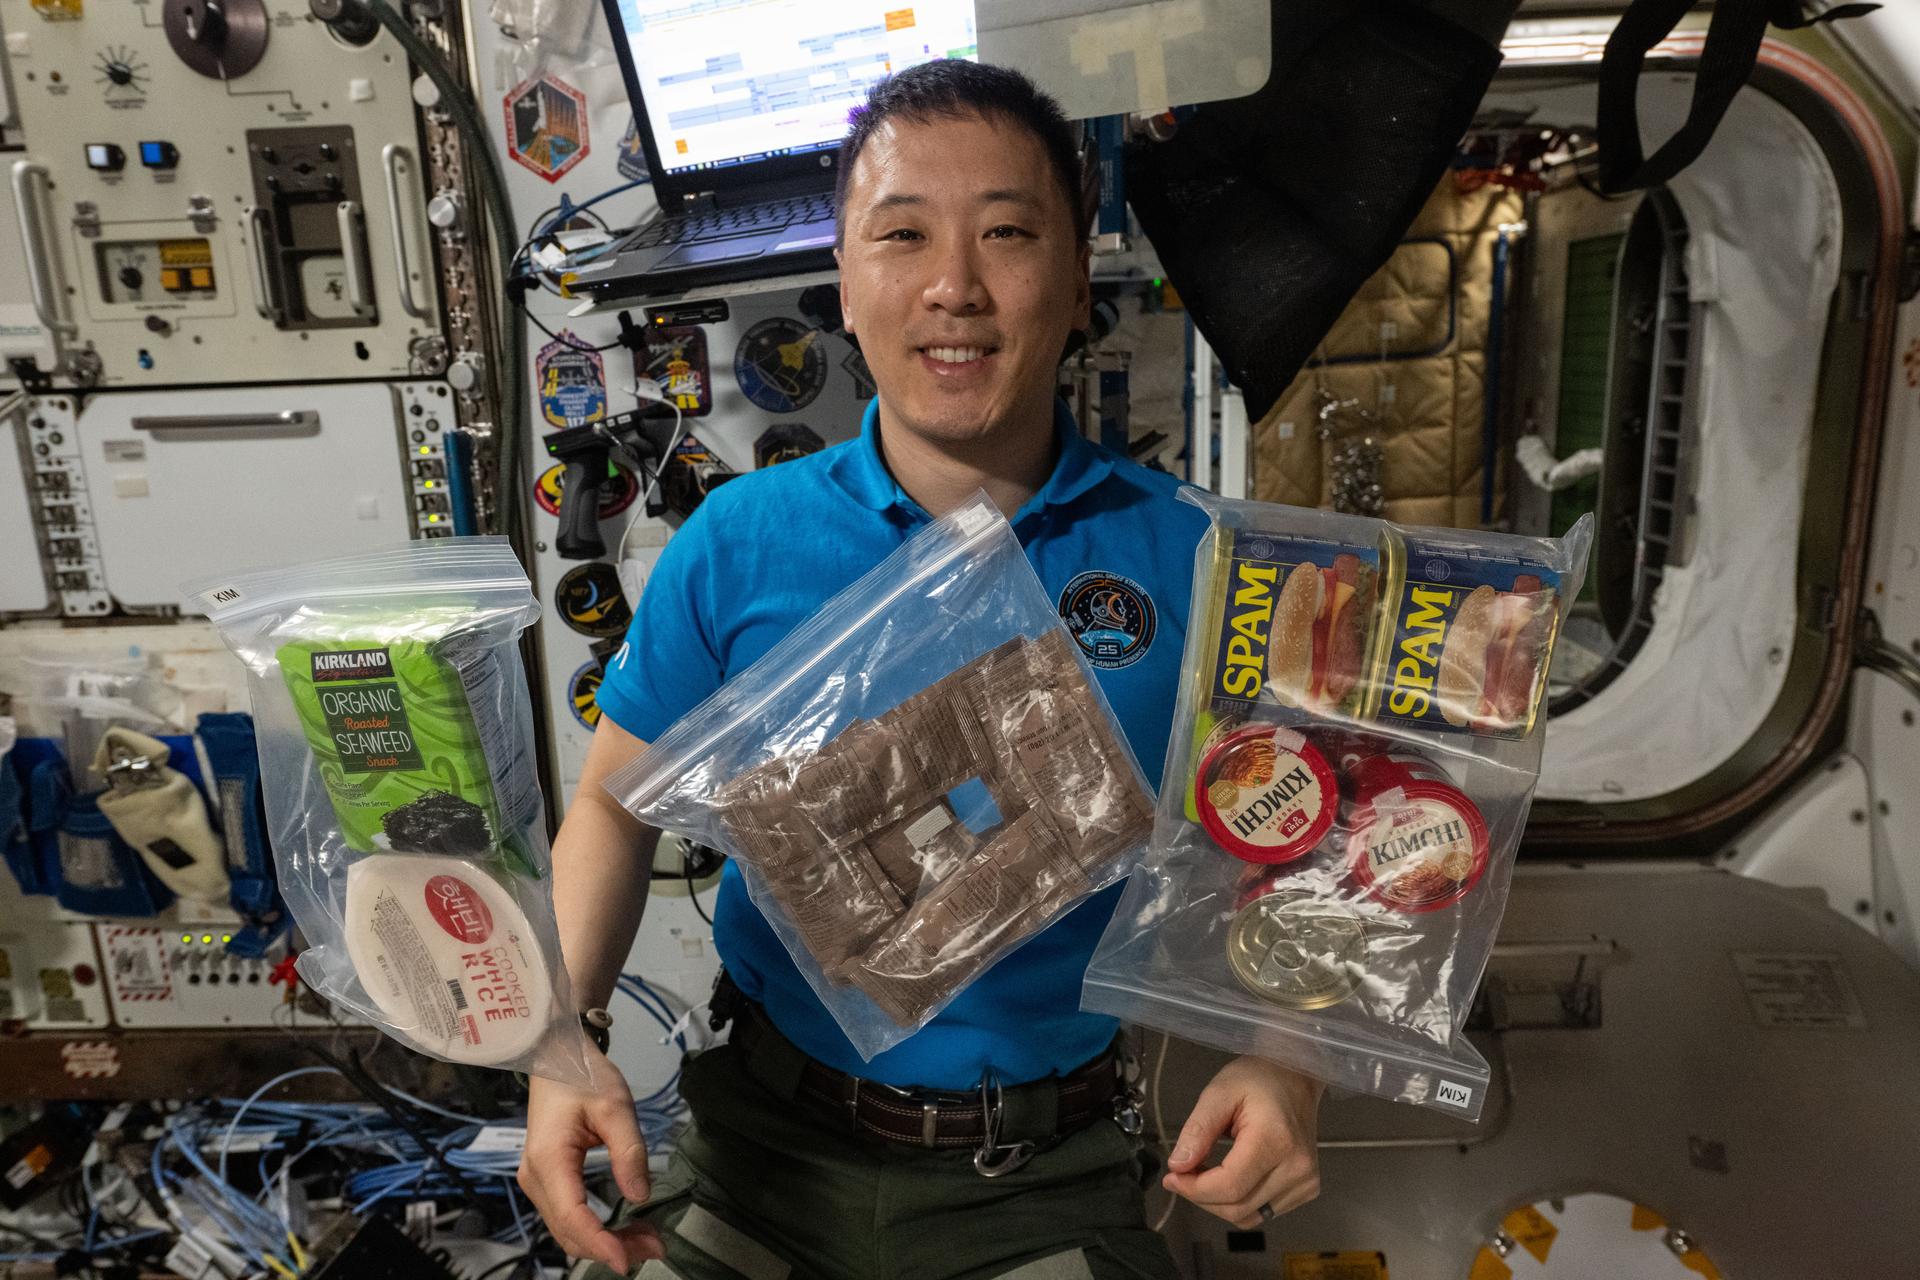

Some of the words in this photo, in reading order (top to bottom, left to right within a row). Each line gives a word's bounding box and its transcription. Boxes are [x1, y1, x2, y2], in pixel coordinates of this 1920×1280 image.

[213, 588, 240, 604] KIM
[1067, 573, 1105, 594] INTERNATIONAL
[1124, 576, 1147, 597] STATION
[1222, 563, 1278, 698] SPAM
[315, 652, 388, 670] KIRKLAND
[1095, 659, 1119, 668] HUMAN
[1119, 645, 1147, 667] PRESENCE
[1097, 644, 1118, 655] 25
[1389, 587, 1453, 718] SPAM
[323, 688, 401, 716] ORGANIC
[344, 713, 391, 729] Roasted
[335, 731, 411, 756] SEAWEED
[366, 755, 399, 768] Snack
[1232, 766, 1313, 838] KIMCHI
[1372, 819, 1465, 866] KIMCHI
[432, 882, 484, 936] 햇반
[461, 953, 502, 1023] RICE
[480, 947, 518, 1020] WHITE
[494, 946, 531, 1019] COOKED
[1440, 1085, 1467, 1103] KIM
